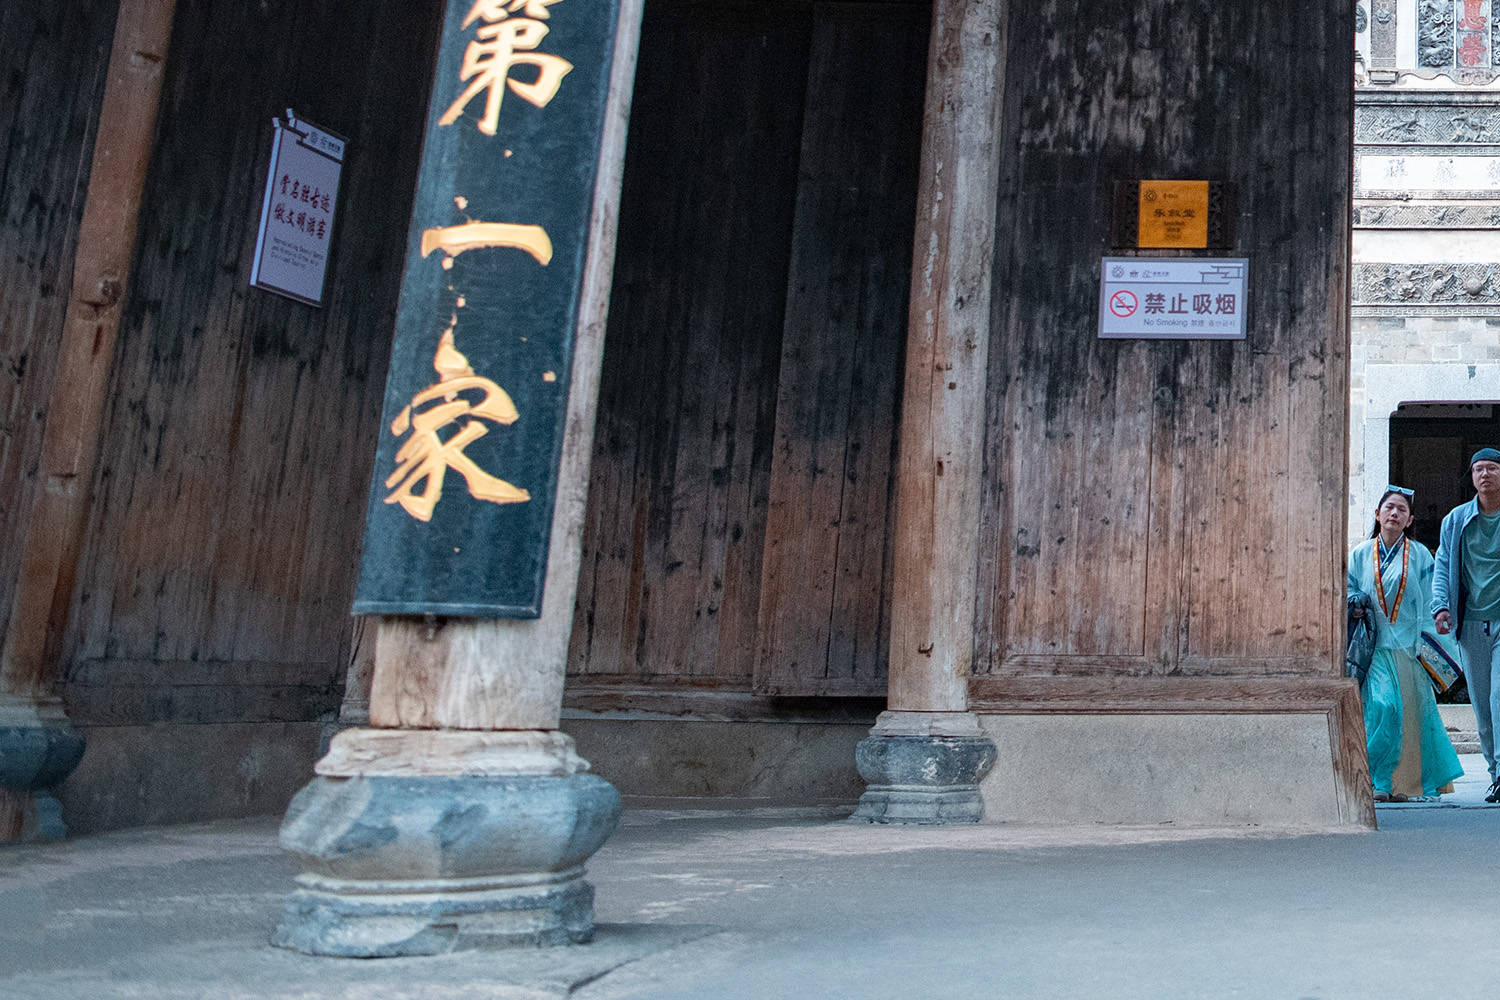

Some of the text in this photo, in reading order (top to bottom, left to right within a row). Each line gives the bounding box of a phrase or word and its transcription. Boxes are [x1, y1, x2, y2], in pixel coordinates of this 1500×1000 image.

[1144, 292, 1236, 315] 禁止吸烟
[1144, 318, 1154, 326] No
[1156, 318, 1188, 328] Smoking
